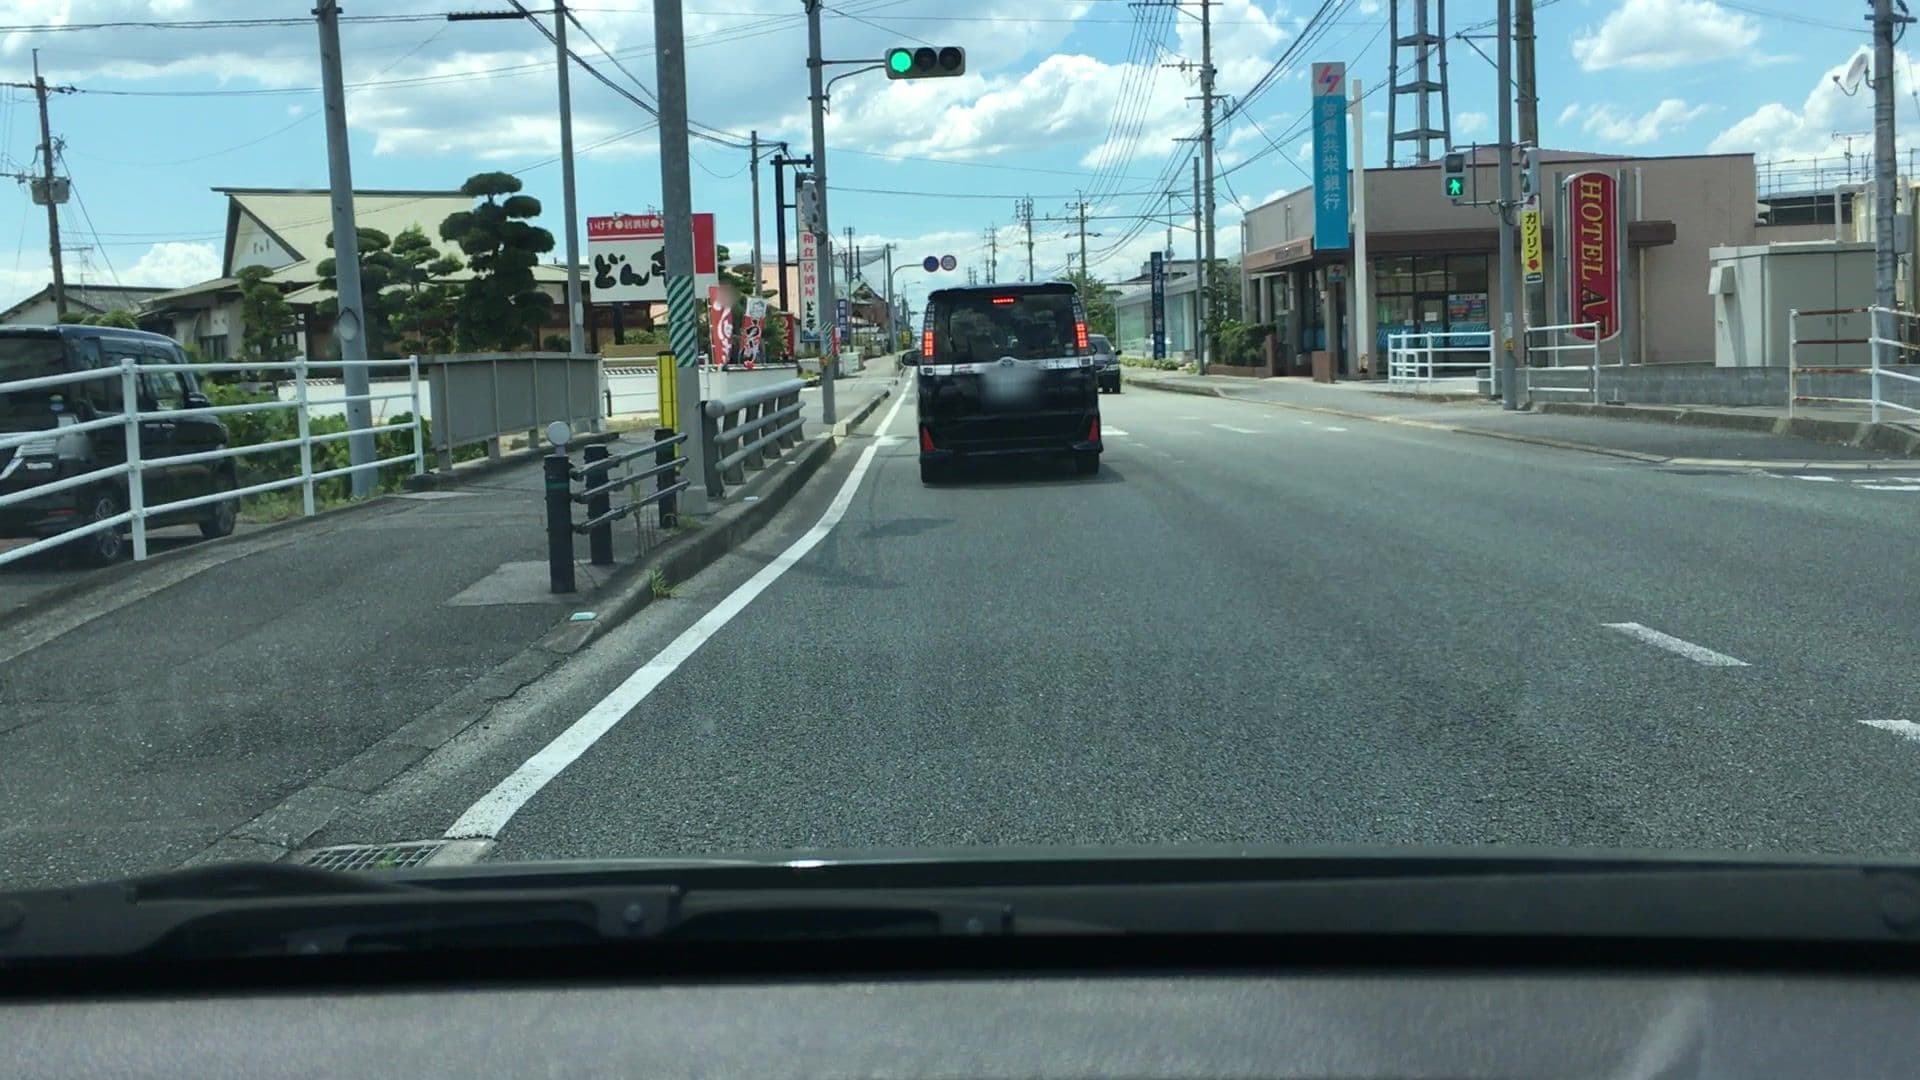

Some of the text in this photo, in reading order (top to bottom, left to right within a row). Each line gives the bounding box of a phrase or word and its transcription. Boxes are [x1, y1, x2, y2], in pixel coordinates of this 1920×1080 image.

[1525, 212, 1540, 260] ガソリン
[1580, 178, 1604, 280] HOTEL
